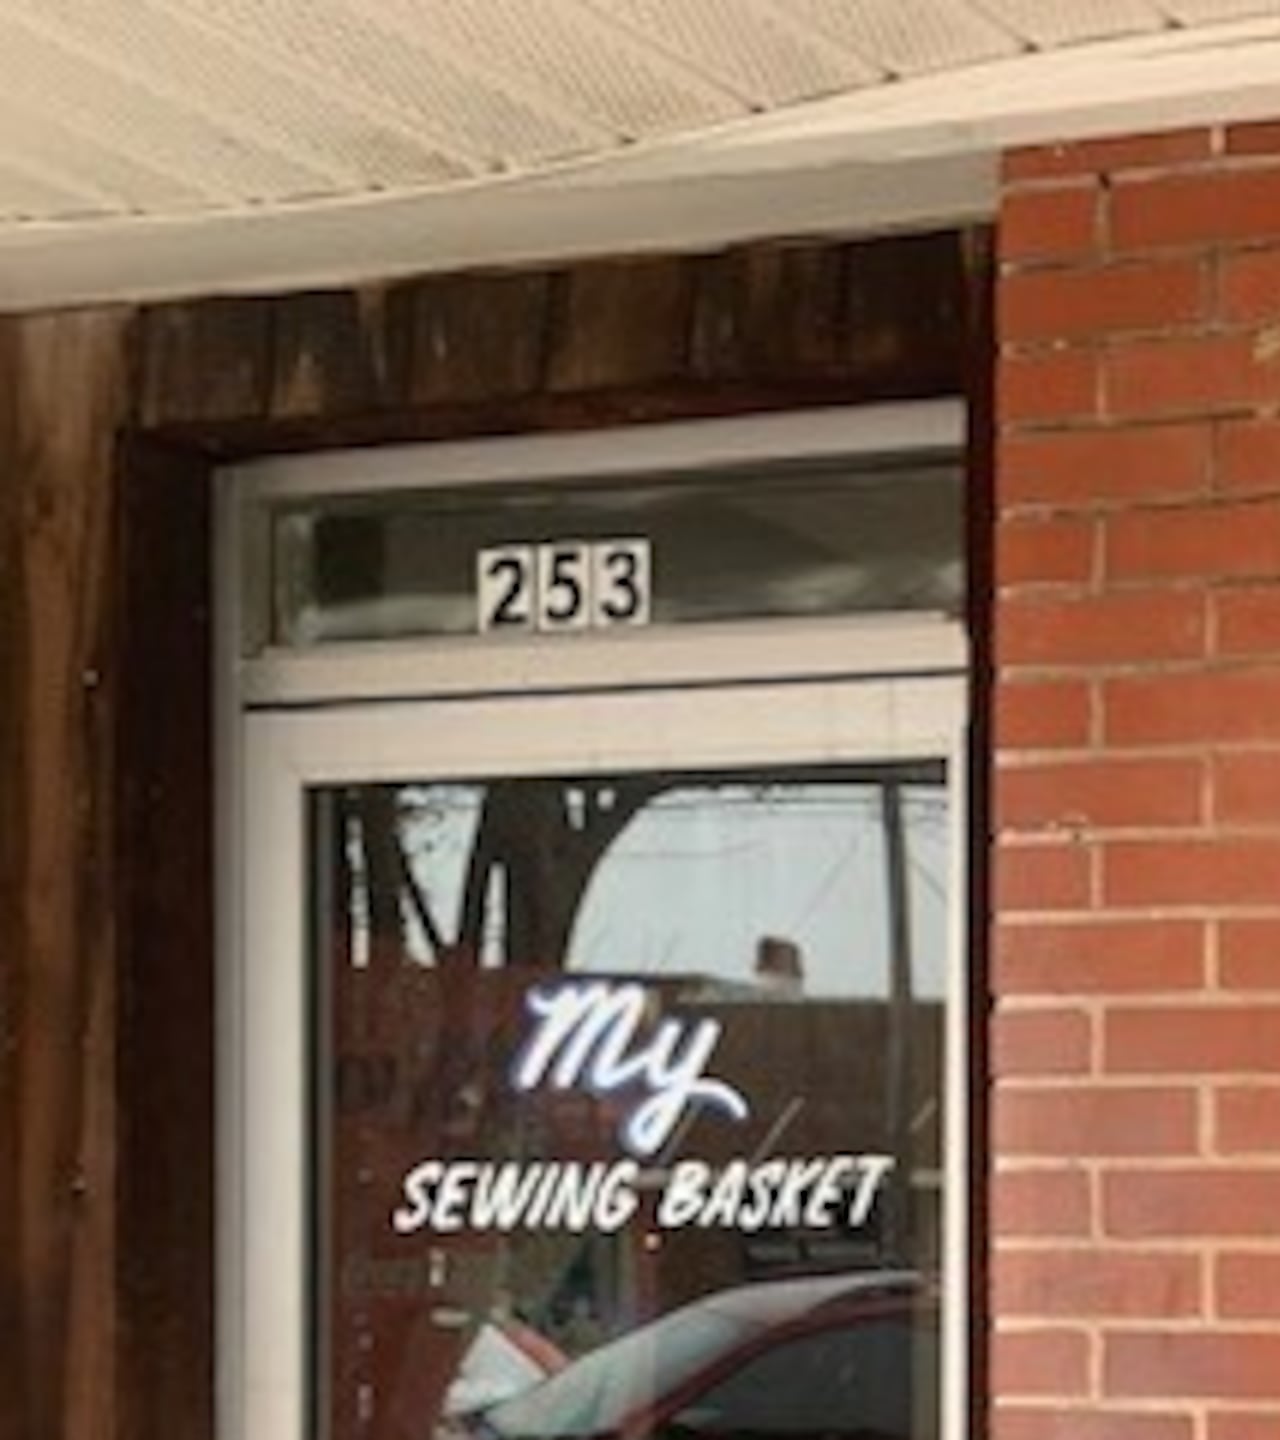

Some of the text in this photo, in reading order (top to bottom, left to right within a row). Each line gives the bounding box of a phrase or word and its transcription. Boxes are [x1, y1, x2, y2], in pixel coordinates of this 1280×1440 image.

[485, 550, 643, 627] 253
[515, 981, 749, 1156] My
[392, 1155, 896, 1233] SEWING BASKET
